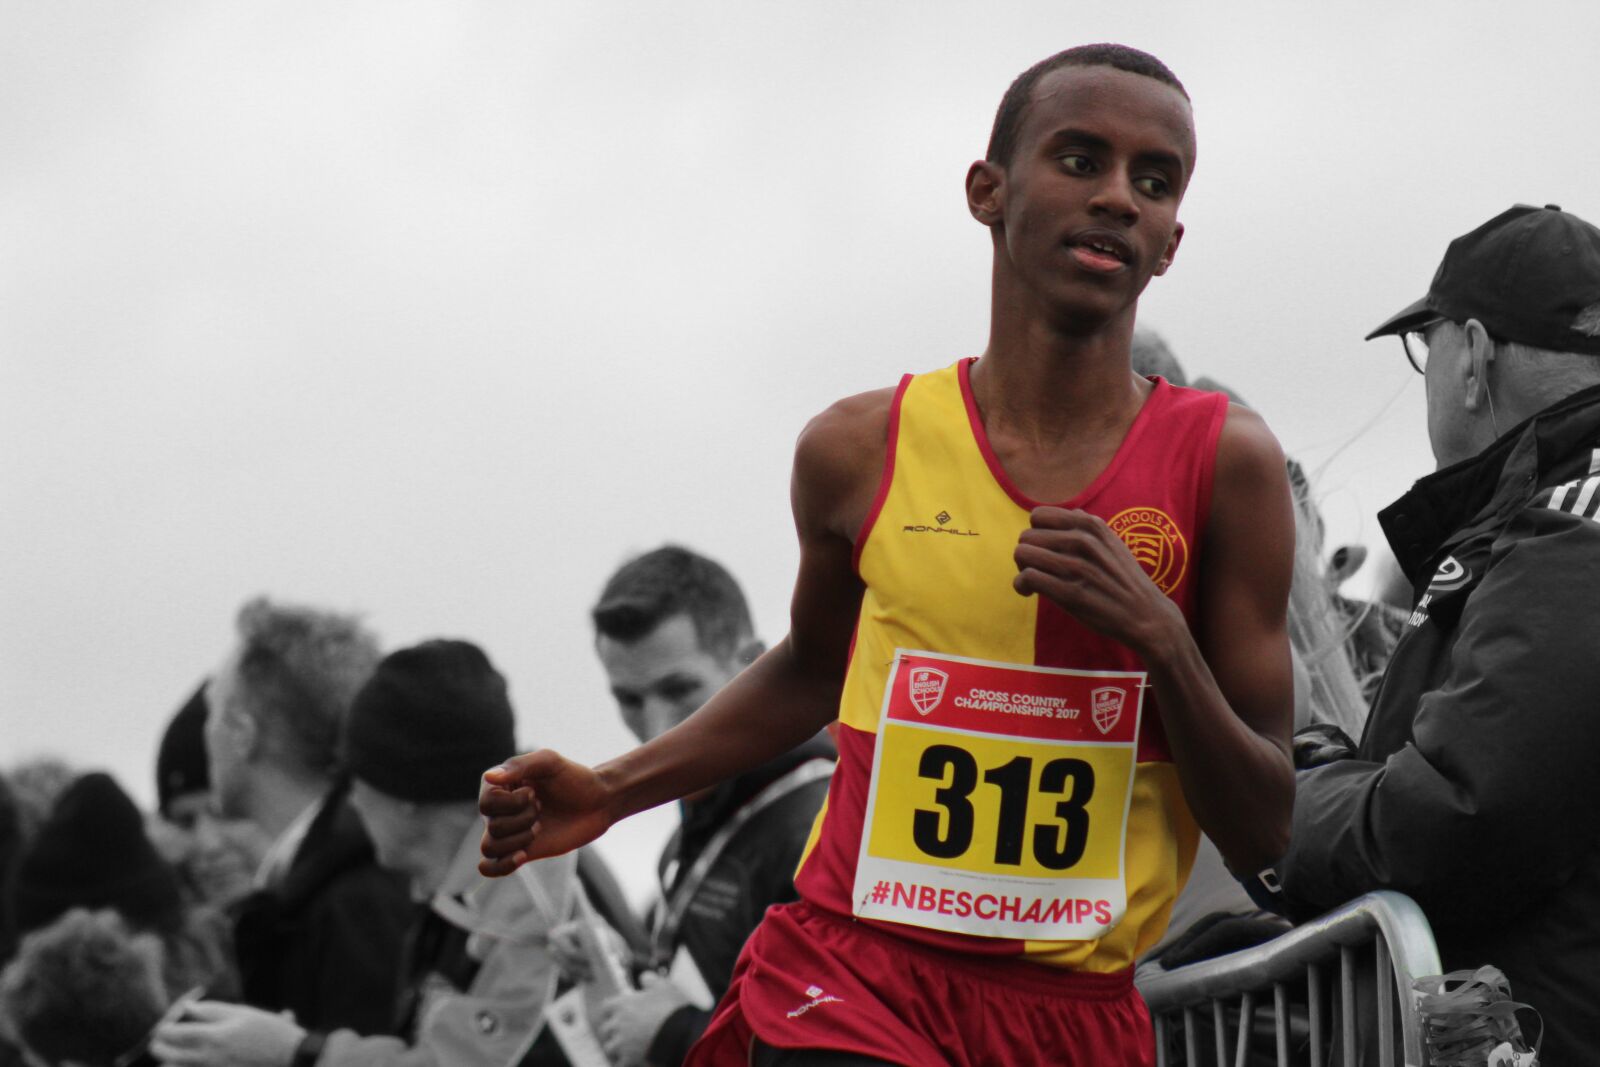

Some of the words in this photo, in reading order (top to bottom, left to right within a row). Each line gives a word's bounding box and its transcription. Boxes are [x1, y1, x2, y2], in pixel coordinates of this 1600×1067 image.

[903, 525, 980, 537] RONHILL
[1112, 511, 1163, 532] CHOOLS
[954, 696, 1054, 718] CHAMPIONSHIPS
[1055, 708, 1080, 719] 2017
[969, 688, 1009, 703] CROSS
[1011, 694, 1067, 708] COUNTRY
[912, 744, 1095, 871] 313
[871, 880, 1113, 926] #NBESCHAMPS
